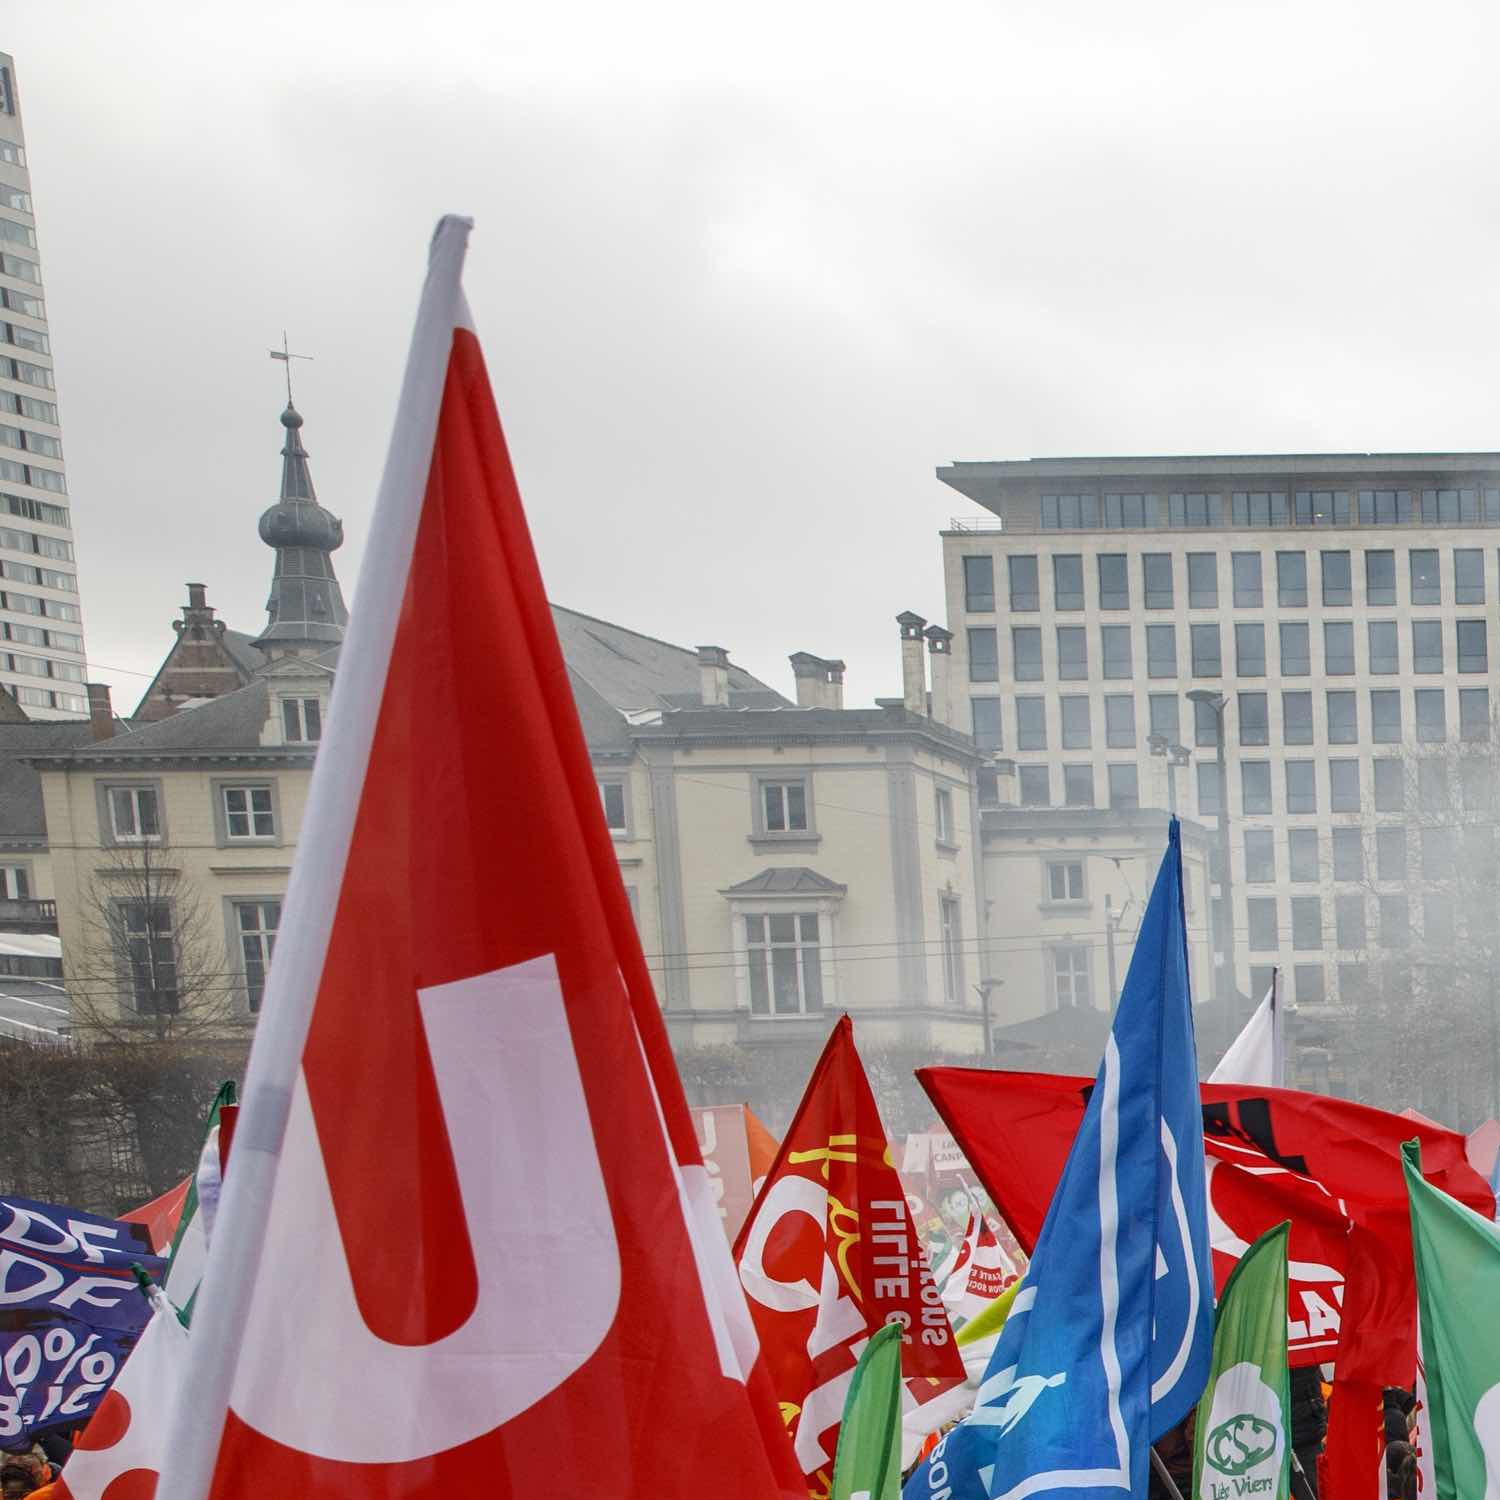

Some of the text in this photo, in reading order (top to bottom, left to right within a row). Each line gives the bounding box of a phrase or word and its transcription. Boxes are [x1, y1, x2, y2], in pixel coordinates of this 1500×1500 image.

[0, 1203, 122, 1263] DF
[0, 1250, 140, 1310] DF
[0, 1326, 116, 1389] 0%
[1208, 1417, 1276, 1466] CSC
